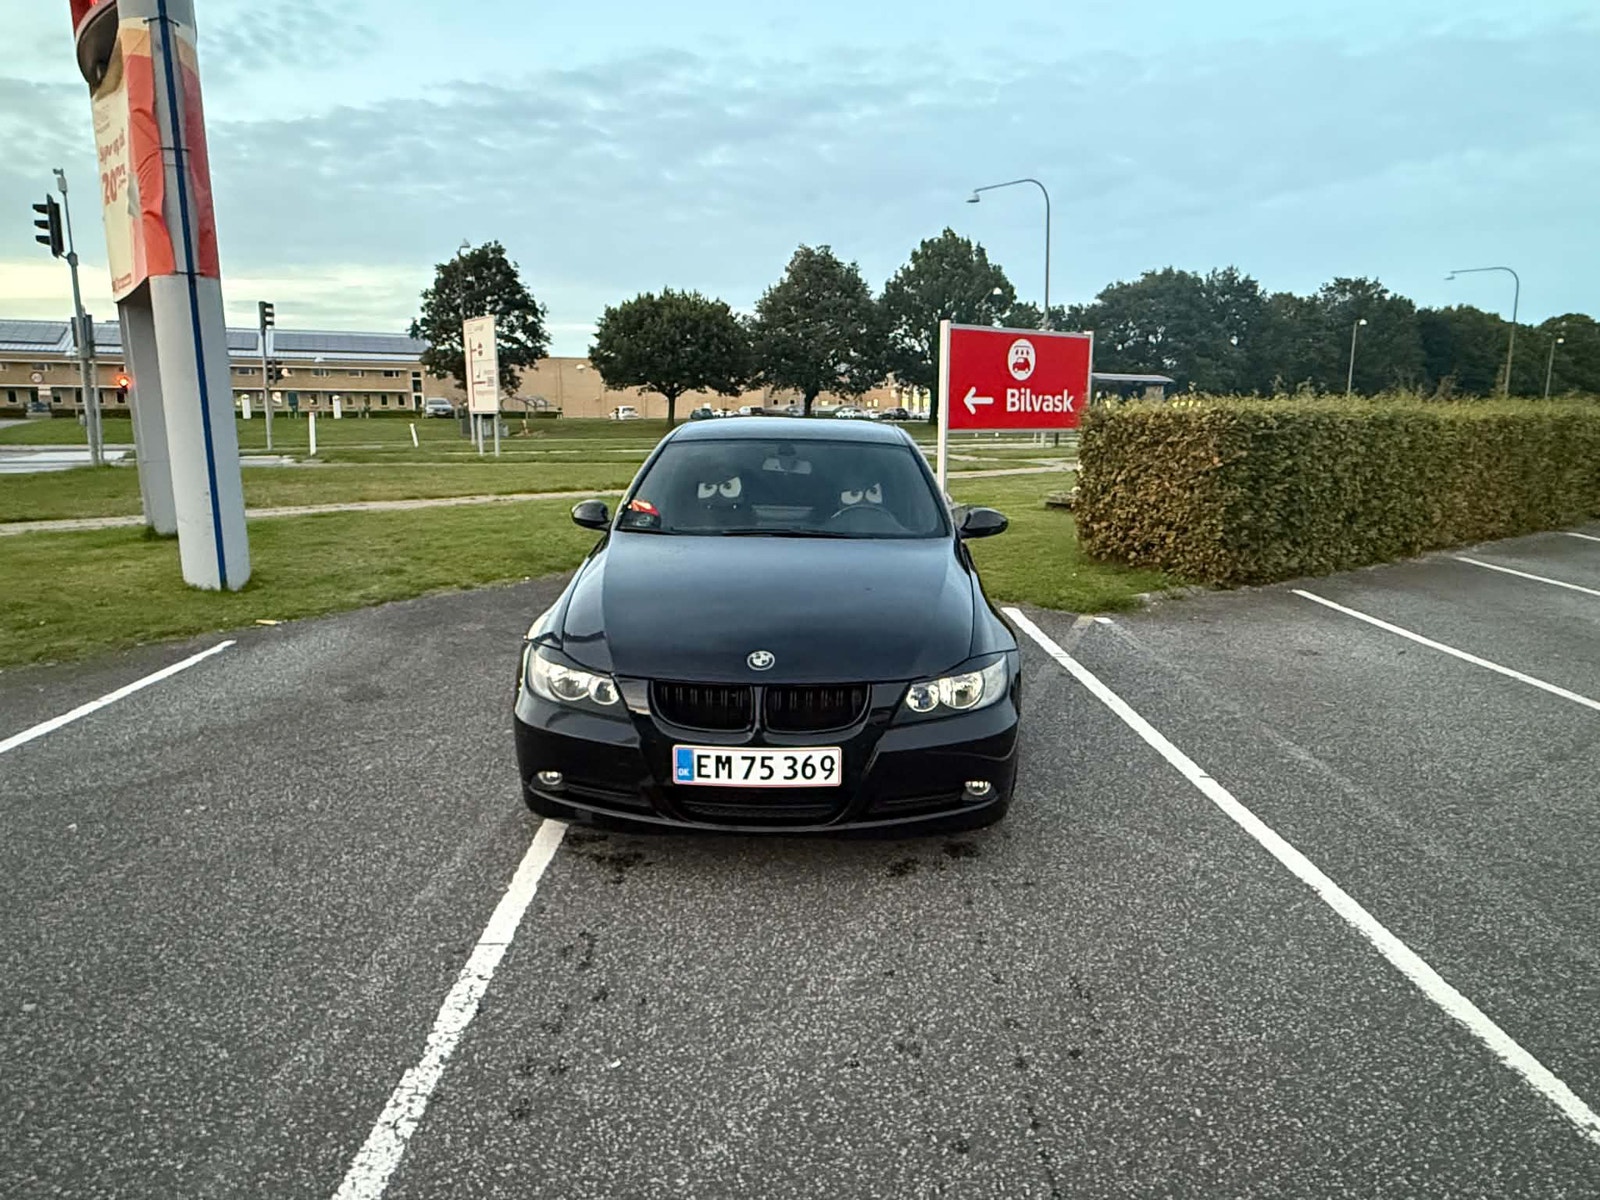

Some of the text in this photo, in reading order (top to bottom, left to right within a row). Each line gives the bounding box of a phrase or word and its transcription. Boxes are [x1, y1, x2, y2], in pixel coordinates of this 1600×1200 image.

[1006, 388, 1074, 412] Bilvask
[678, 768, 690, 776] DK
[697, 755, 836, 780] EM 75 369
